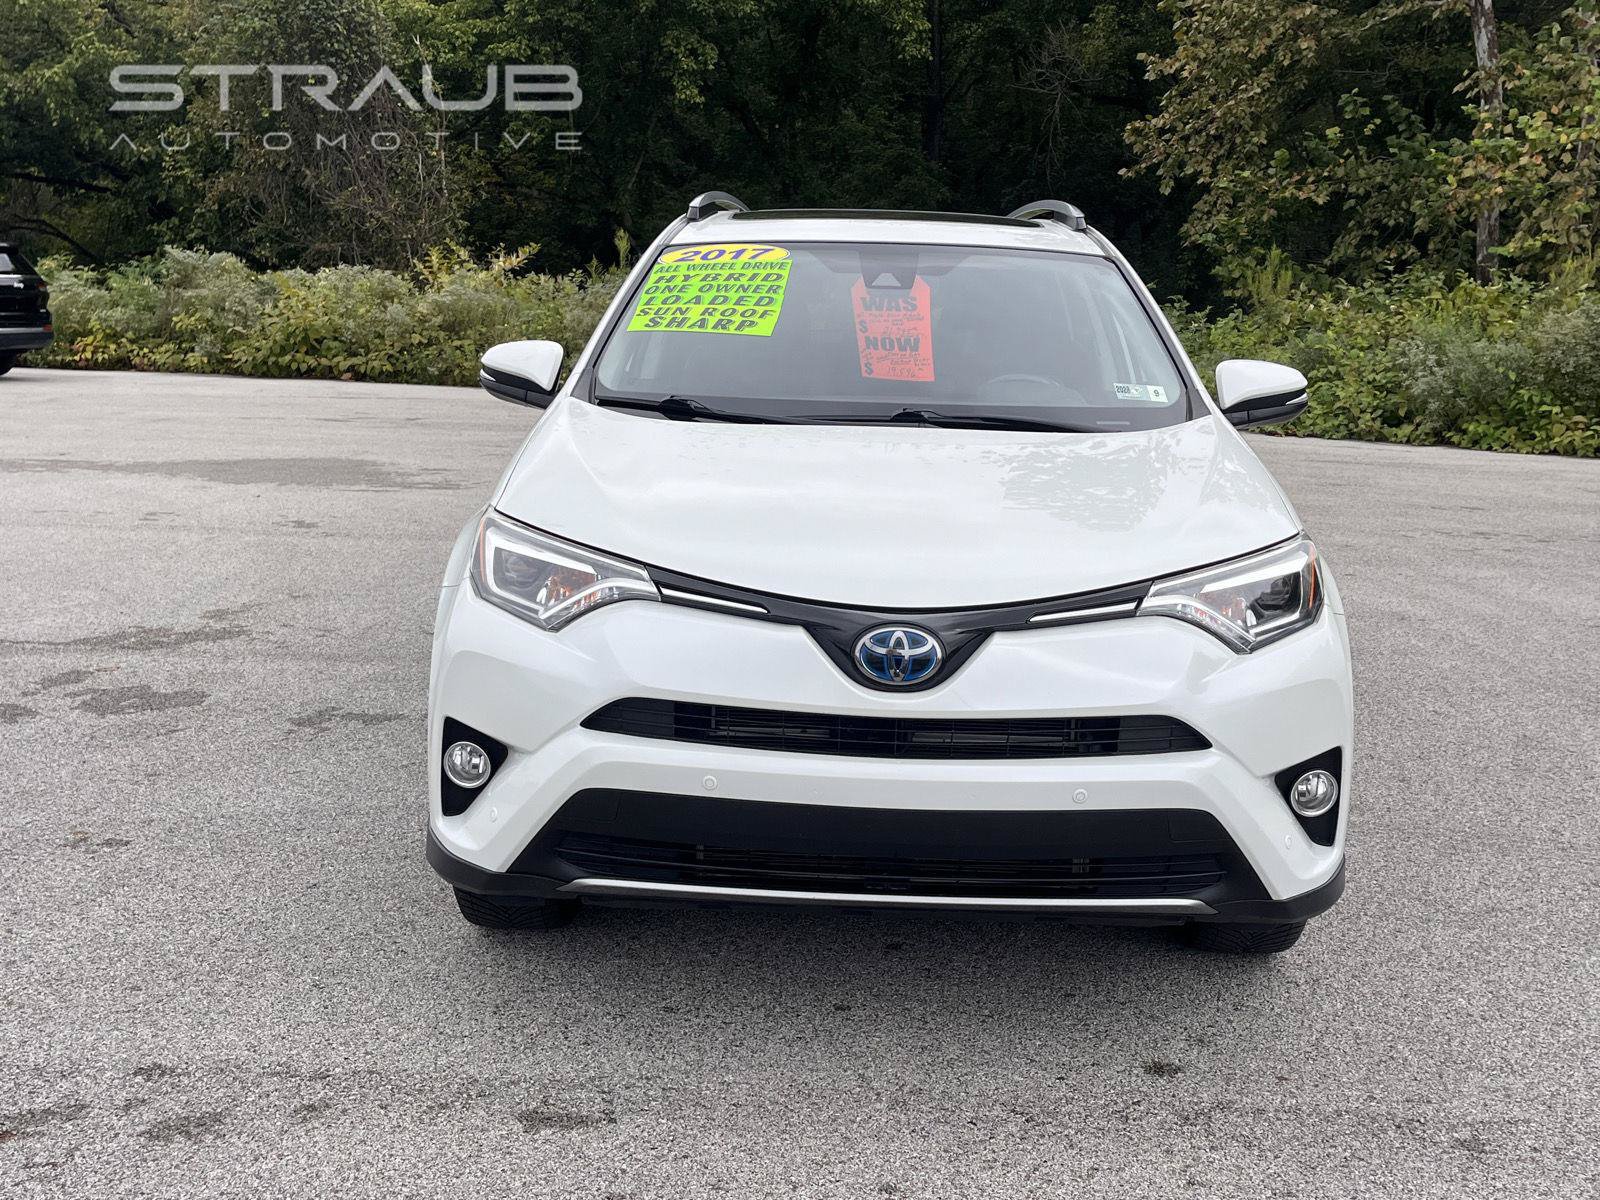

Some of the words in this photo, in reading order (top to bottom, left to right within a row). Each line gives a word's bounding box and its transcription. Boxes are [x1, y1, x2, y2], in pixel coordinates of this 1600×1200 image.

[673, 248, 776, 263] 2017
[656, 264, 681, 273] ALL
[686, 262, 737, 272] WHEEL
[741, 261, 788, 271] DRIVE
[653, 272, 785, 285] HYBRID
[644, 283, 694, 295] ONE
[698, 283, 784, 295] OWNER
[641, 294, 775, 307] LOADED
[860, 297, 918, 312] WAS
[636, 306, 690, 317] SUN
[700, 307, 776, 320] ROOF
[644, 316, 759, 332] SHARP
[864, 335, 921, 352] NOW
